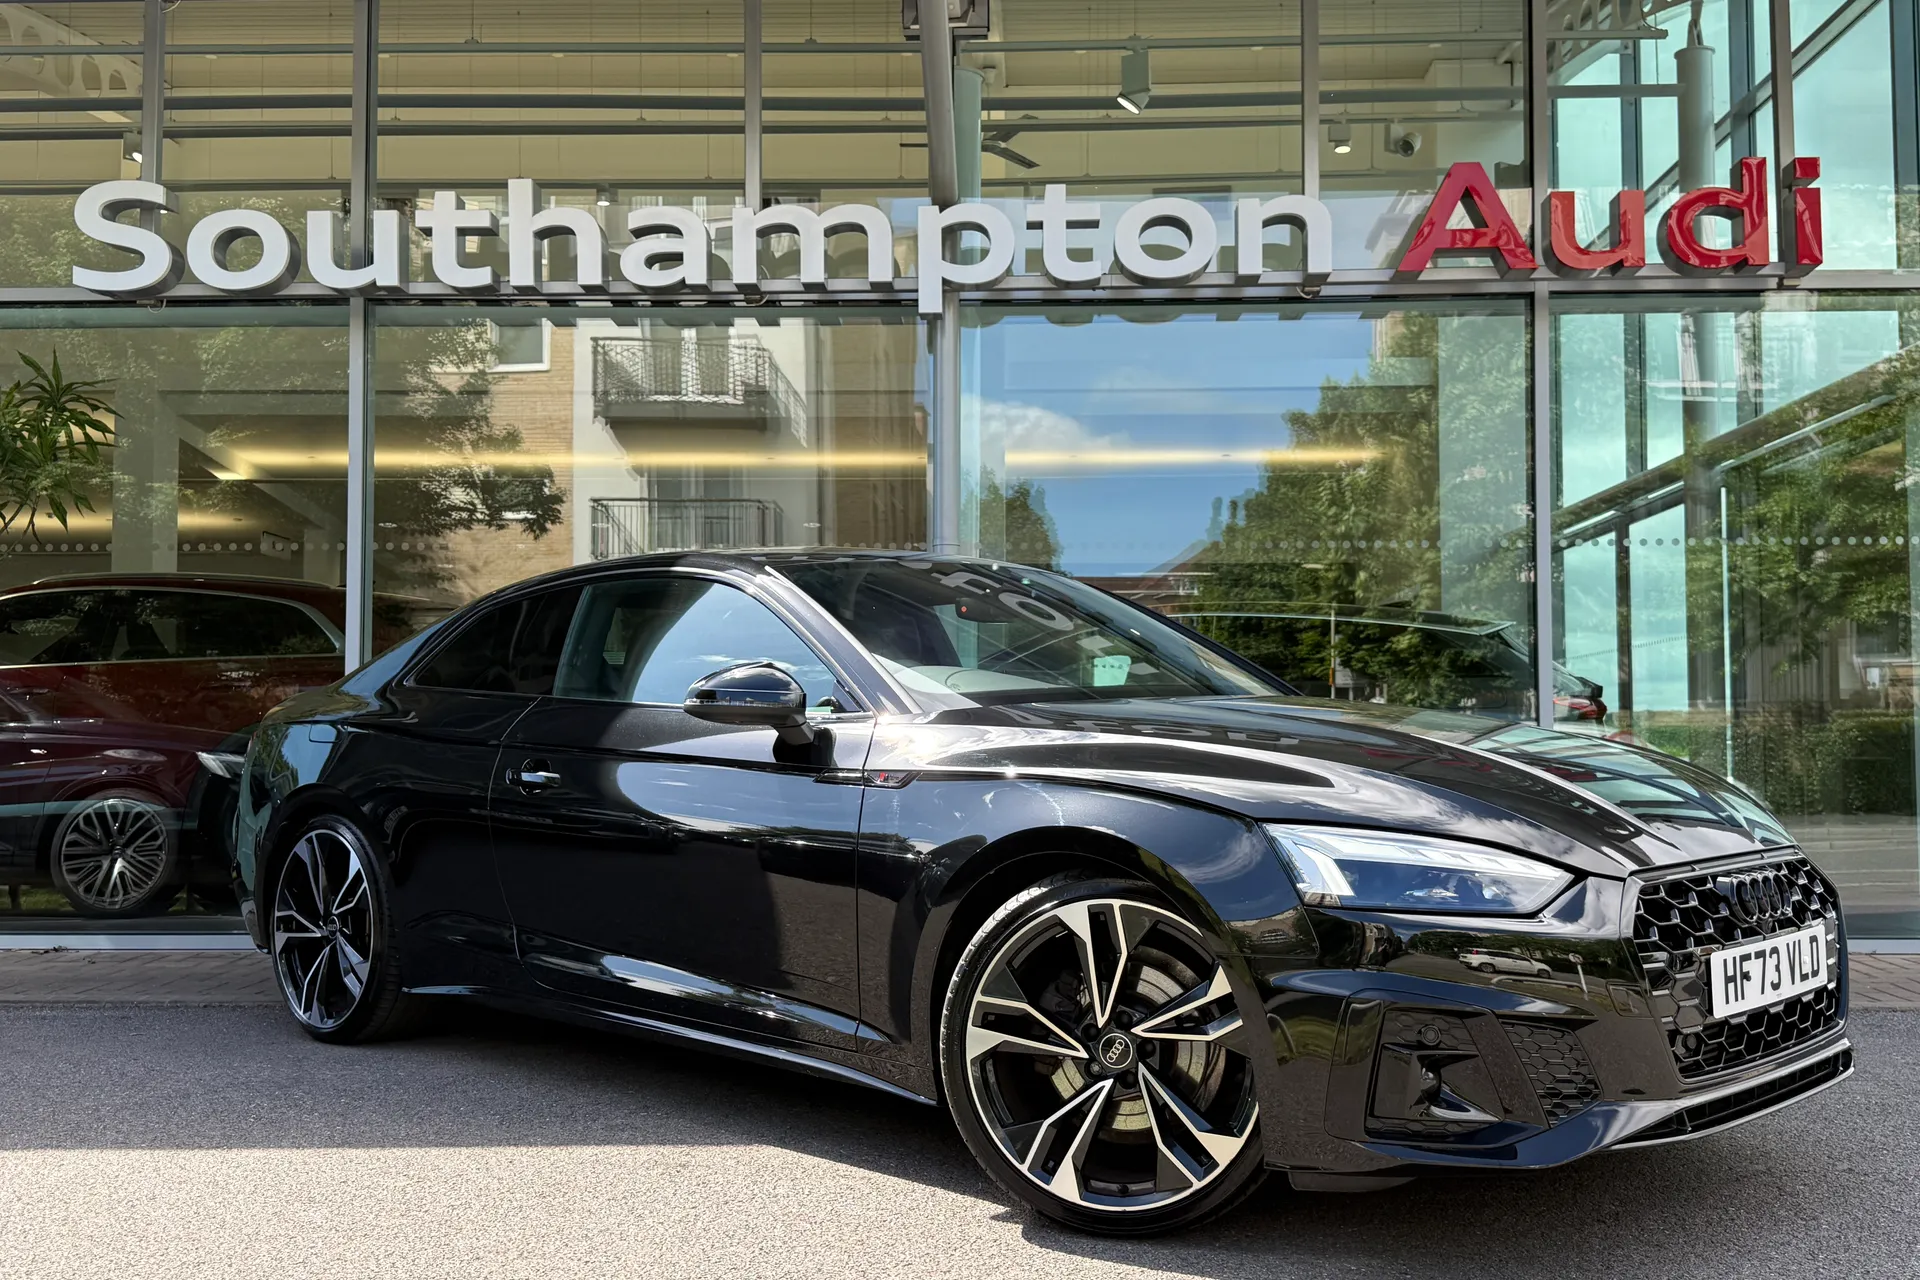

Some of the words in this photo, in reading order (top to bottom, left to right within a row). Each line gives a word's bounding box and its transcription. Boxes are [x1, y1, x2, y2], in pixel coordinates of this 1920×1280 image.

[72, 177, 1333, 315] Southampton
[1396, 156, 1824, 272] Audi
[1722, 945, 1782, 1005] HF73
[1785, 934, 1821, 986] VLD
